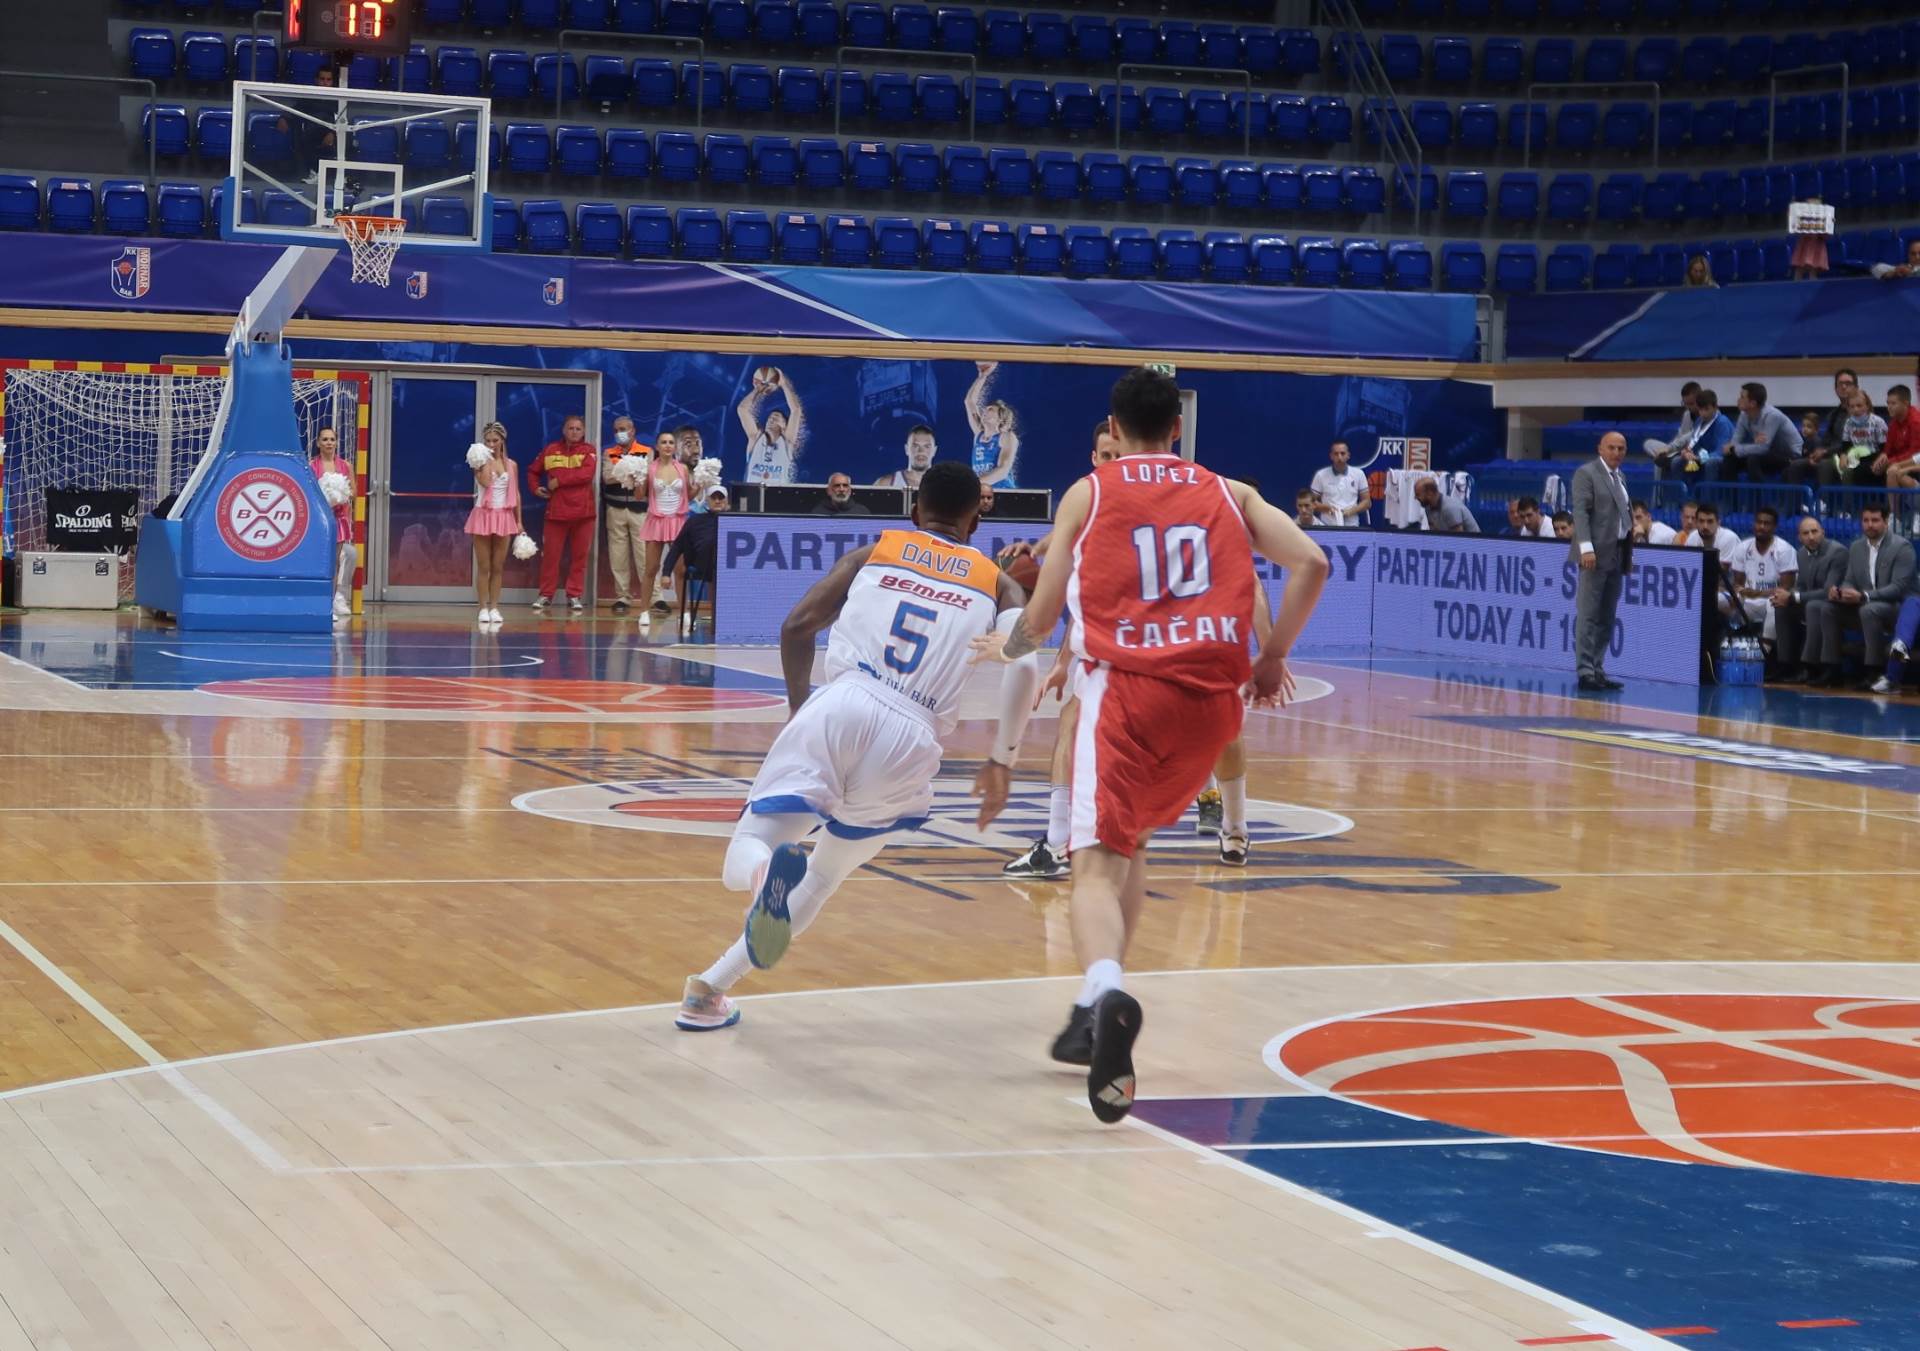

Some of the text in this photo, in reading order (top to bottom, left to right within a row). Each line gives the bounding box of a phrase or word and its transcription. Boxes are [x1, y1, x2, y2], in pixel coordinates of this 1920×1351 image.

[349, 2, 381, 37] 17
[139, 249, 149, 288] MORNAR
[1383, 441, 1402, 455] KK
[1122, 463, 1198, 485] LOPEZ
[55, 513, 112, 528] SPALDING
[901, 543, 972, 578] DAVIS
[1132, 523, 1212, 601] 10
[1378, 546, 1488, 592] PARTIZAN
[1496, 553, 1536, 597] NIS
[1620, 564, 1699, 610] ERBY
[879, 574, 973, 608] BEMAX
[884, 600, 938, 675] 5
[1115, 615, 1239, 649] ČAČAK
[1434, 600, 1513, 645] TODAY
[1518, 609, 1551, 650] AT
